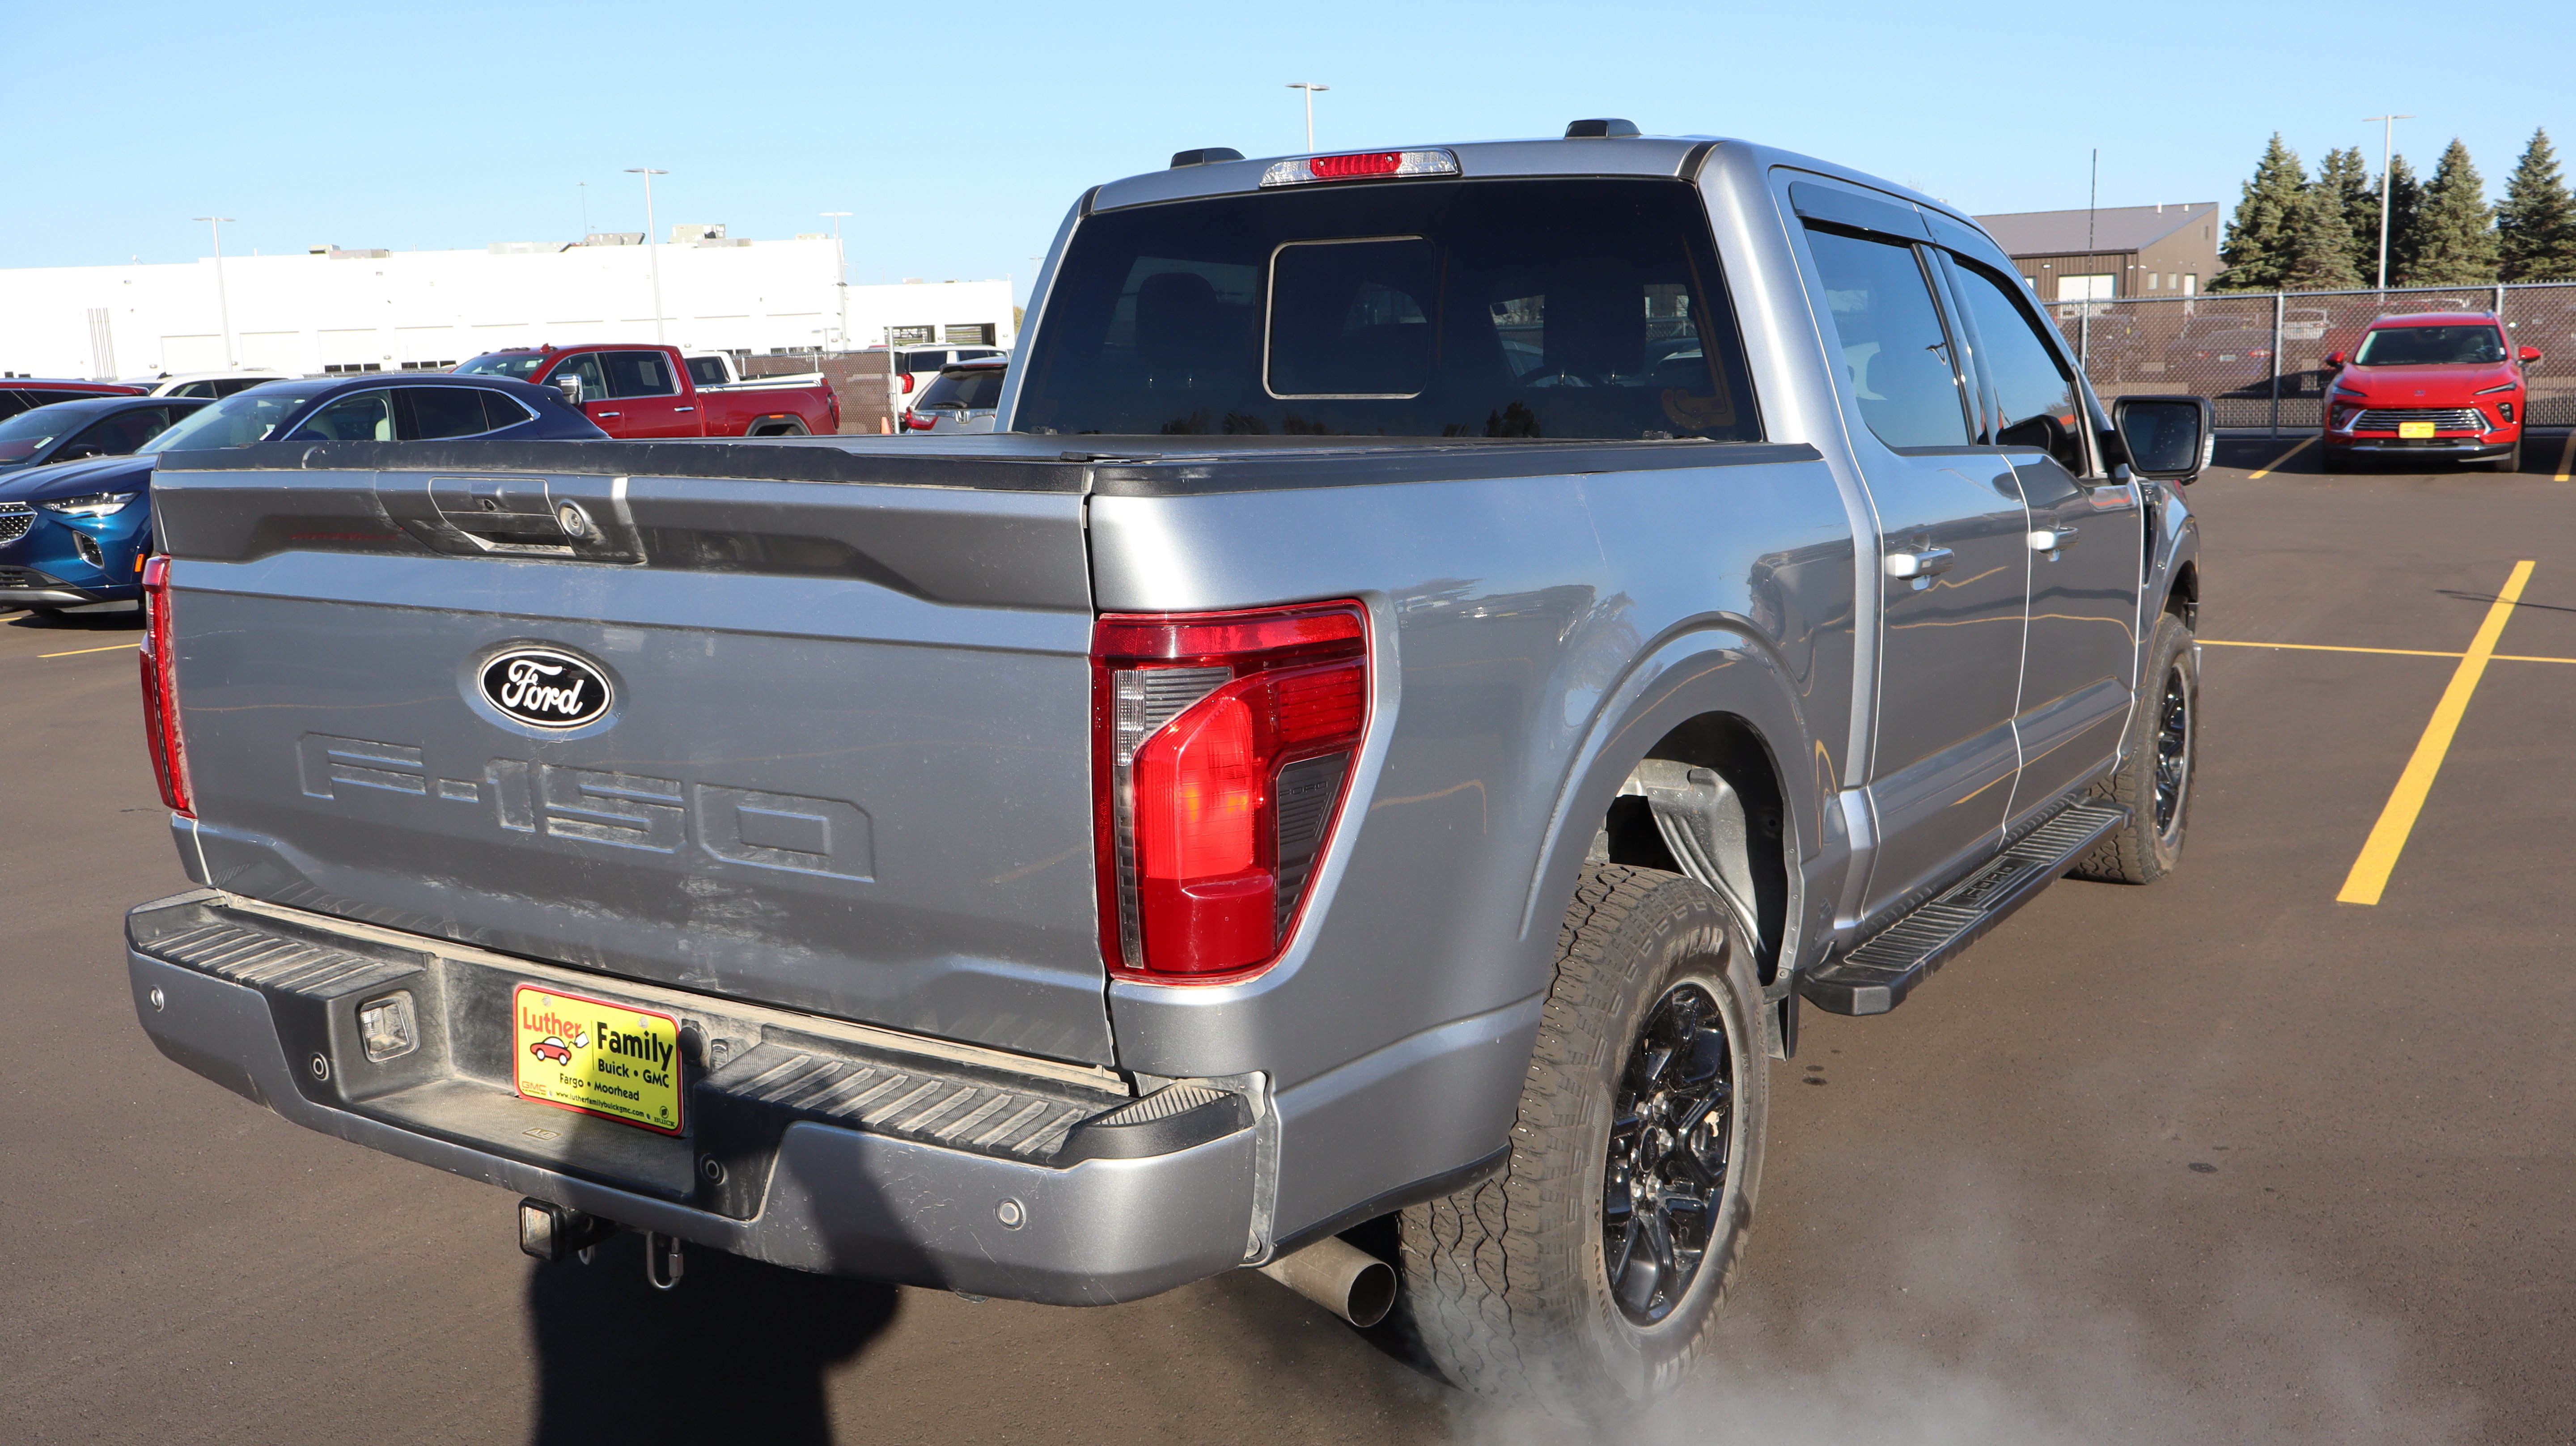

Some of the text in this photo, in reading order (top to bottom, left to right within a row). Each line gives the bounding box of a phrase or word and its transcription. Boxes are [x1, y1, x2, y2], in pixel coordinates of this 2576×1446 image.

[501, 660, 584, 715] Ford
[1279, 781, 1328, 799] FORD
[297, 731, 875, 882] F-150
[1959, 865, 2019, 899] FORD
[523, 1007, 582, 1039] Luther
[597, 1021, 674, 1072] Family
[522, 1081, 547, 1092] GMC
[559, 1073, 640, 1101] Fargo Moorhead
[598, 1058, 669, 1088] Buick GMC
[556, 1091, 644, 1117] www.lutherfamilybuickgmc.com
[654, 1117, 675, 1127] BUICK
